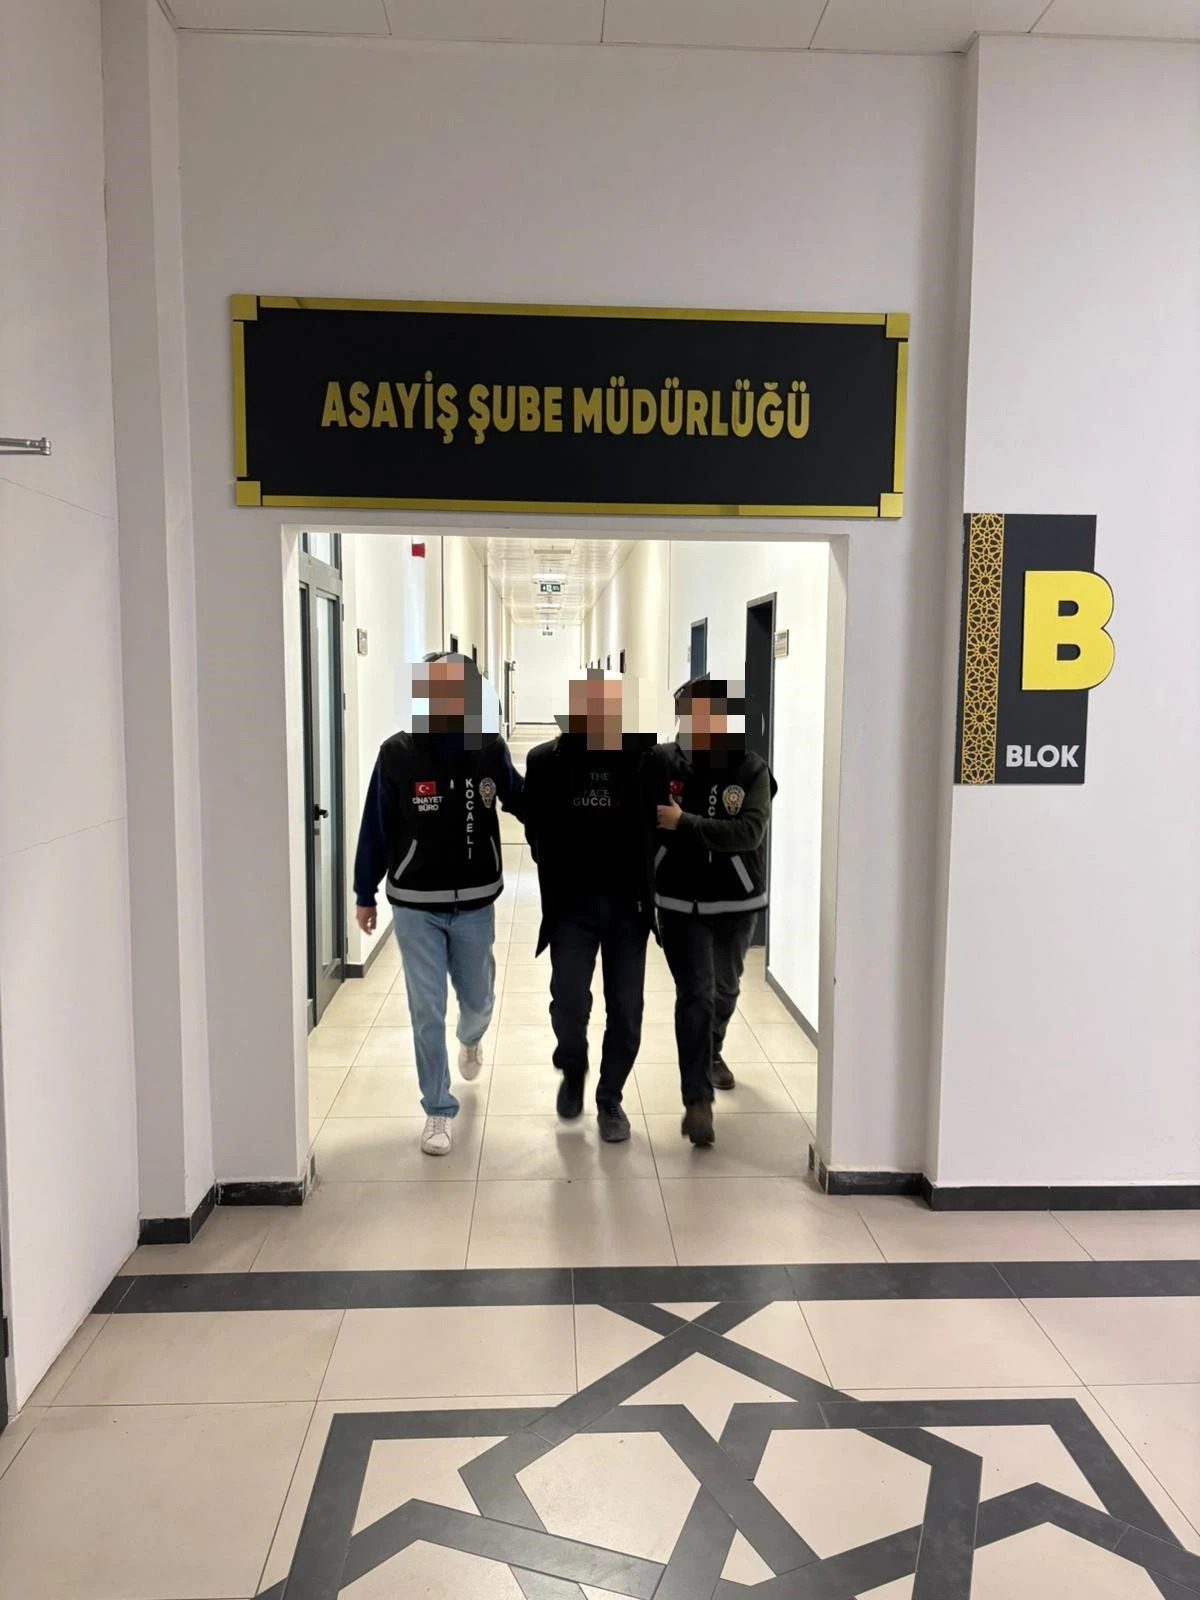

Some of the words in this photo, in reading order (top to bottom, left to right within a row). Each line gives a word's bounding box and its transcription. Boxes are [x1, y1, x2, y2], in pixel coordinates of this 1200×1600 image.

[322, 371, 458, 444] ASAYİŞ
[468, 385, 562, 444] ŞUBE
[573, 376, 810, 439] MÜDÜRLÜĞÜ
[1021, 570, 1115, 691] B
[1005, 744, 1080, 768] BLOK
[572, 797, 611, 807] GUCCI
